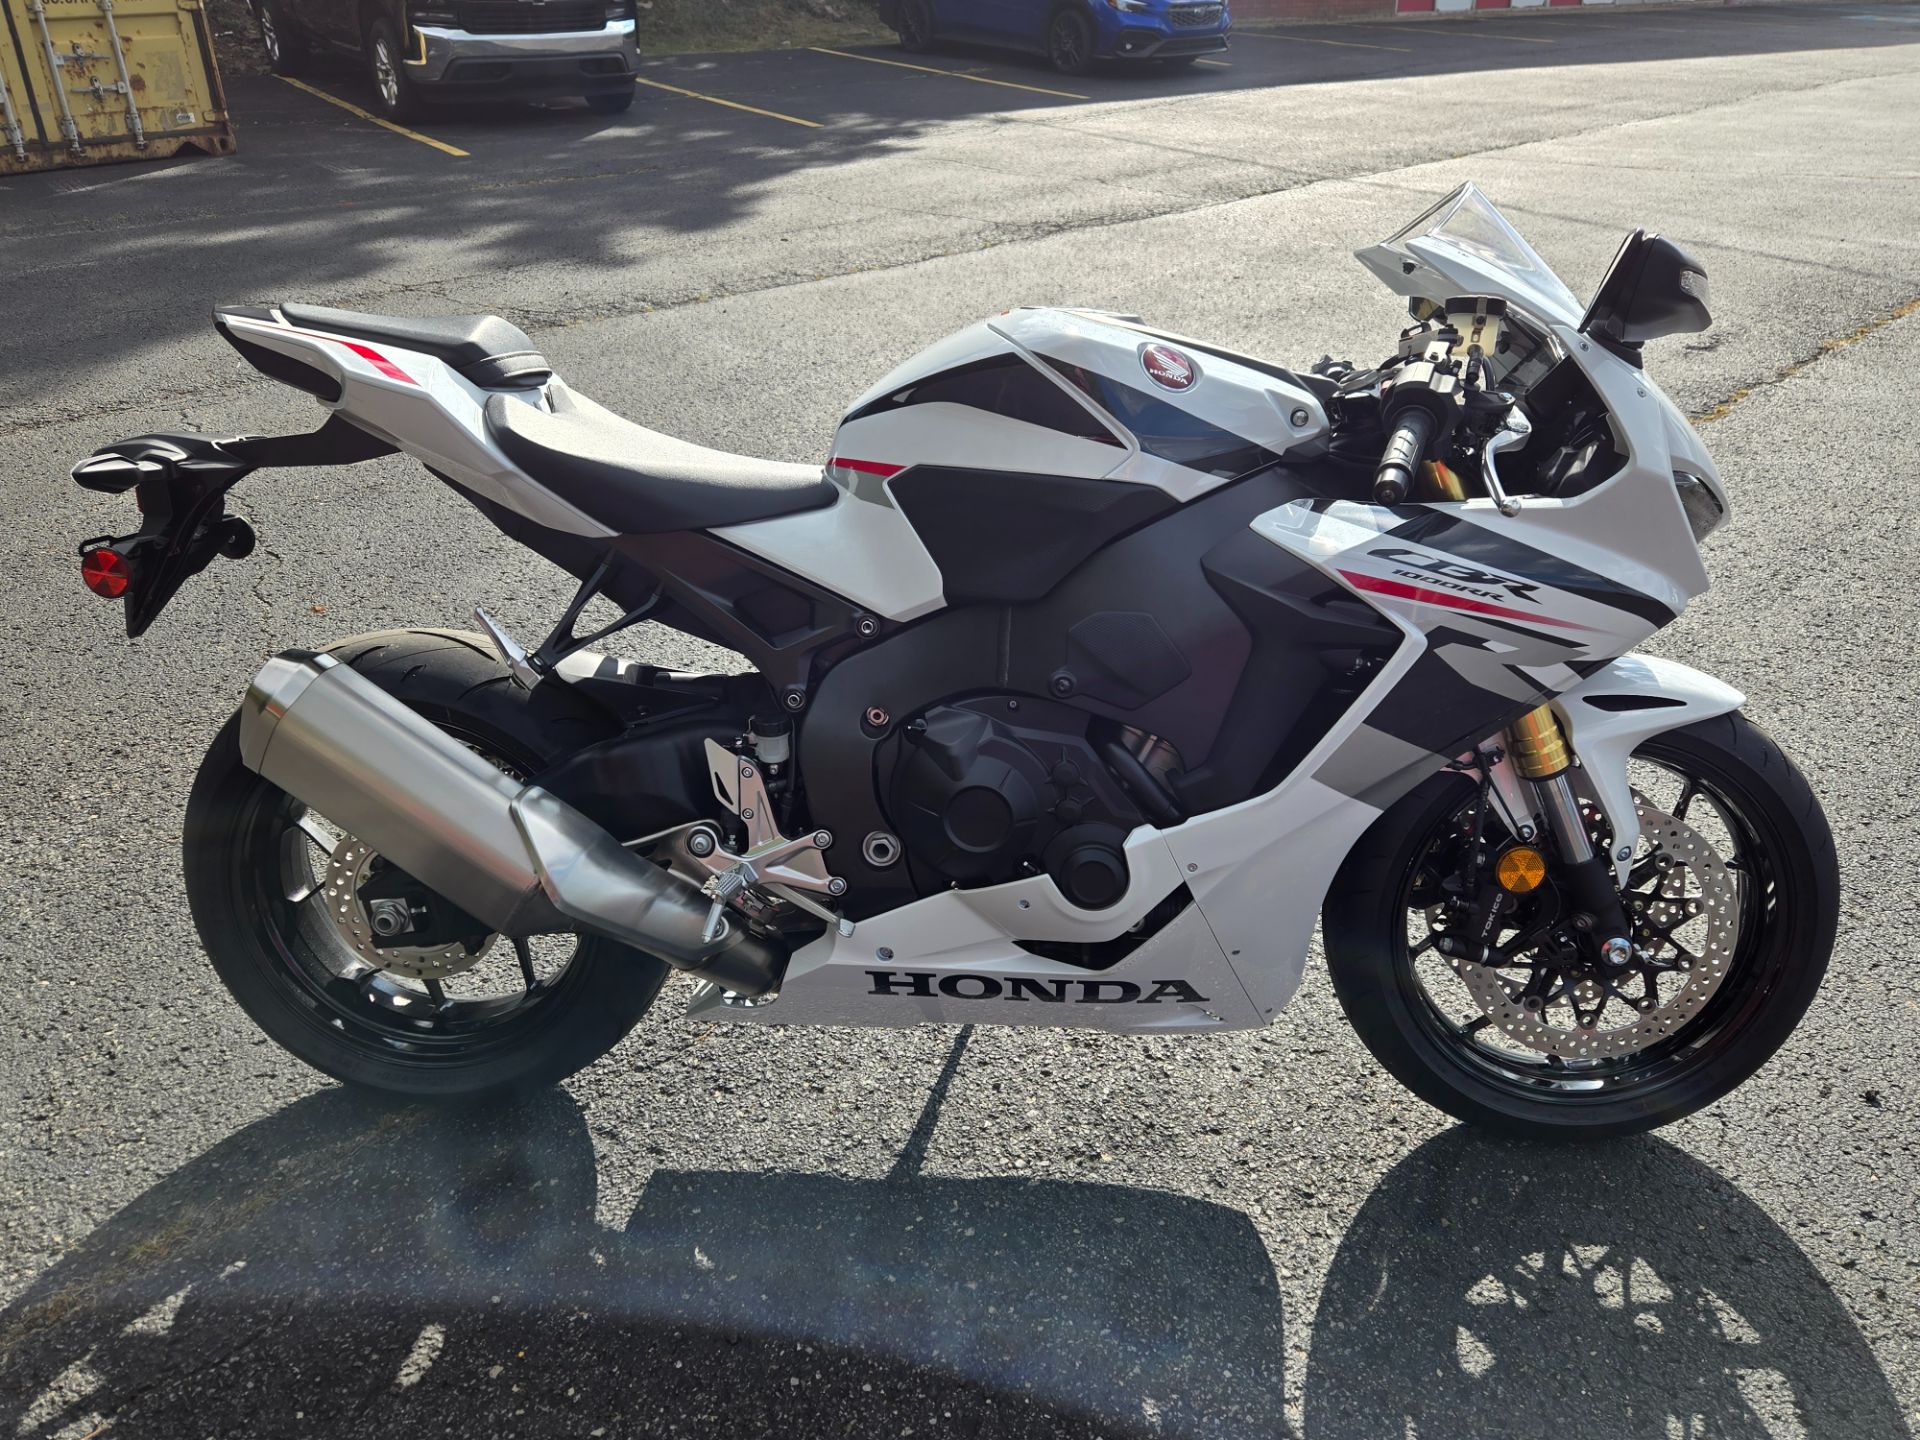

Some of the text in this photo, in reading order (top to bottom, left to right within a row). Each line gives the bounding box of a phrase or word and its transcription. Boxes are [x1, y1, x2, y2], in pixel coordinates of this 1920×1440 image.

[1149, 368, 1188, 385] HONDA
[1366, 548, 1543, 605] CBR
[1391, 568, 1505, 603] 1000RR
[1480, 893, 1503, 938] TOKICO
[864, 970, 1211, 1004] HONDA
